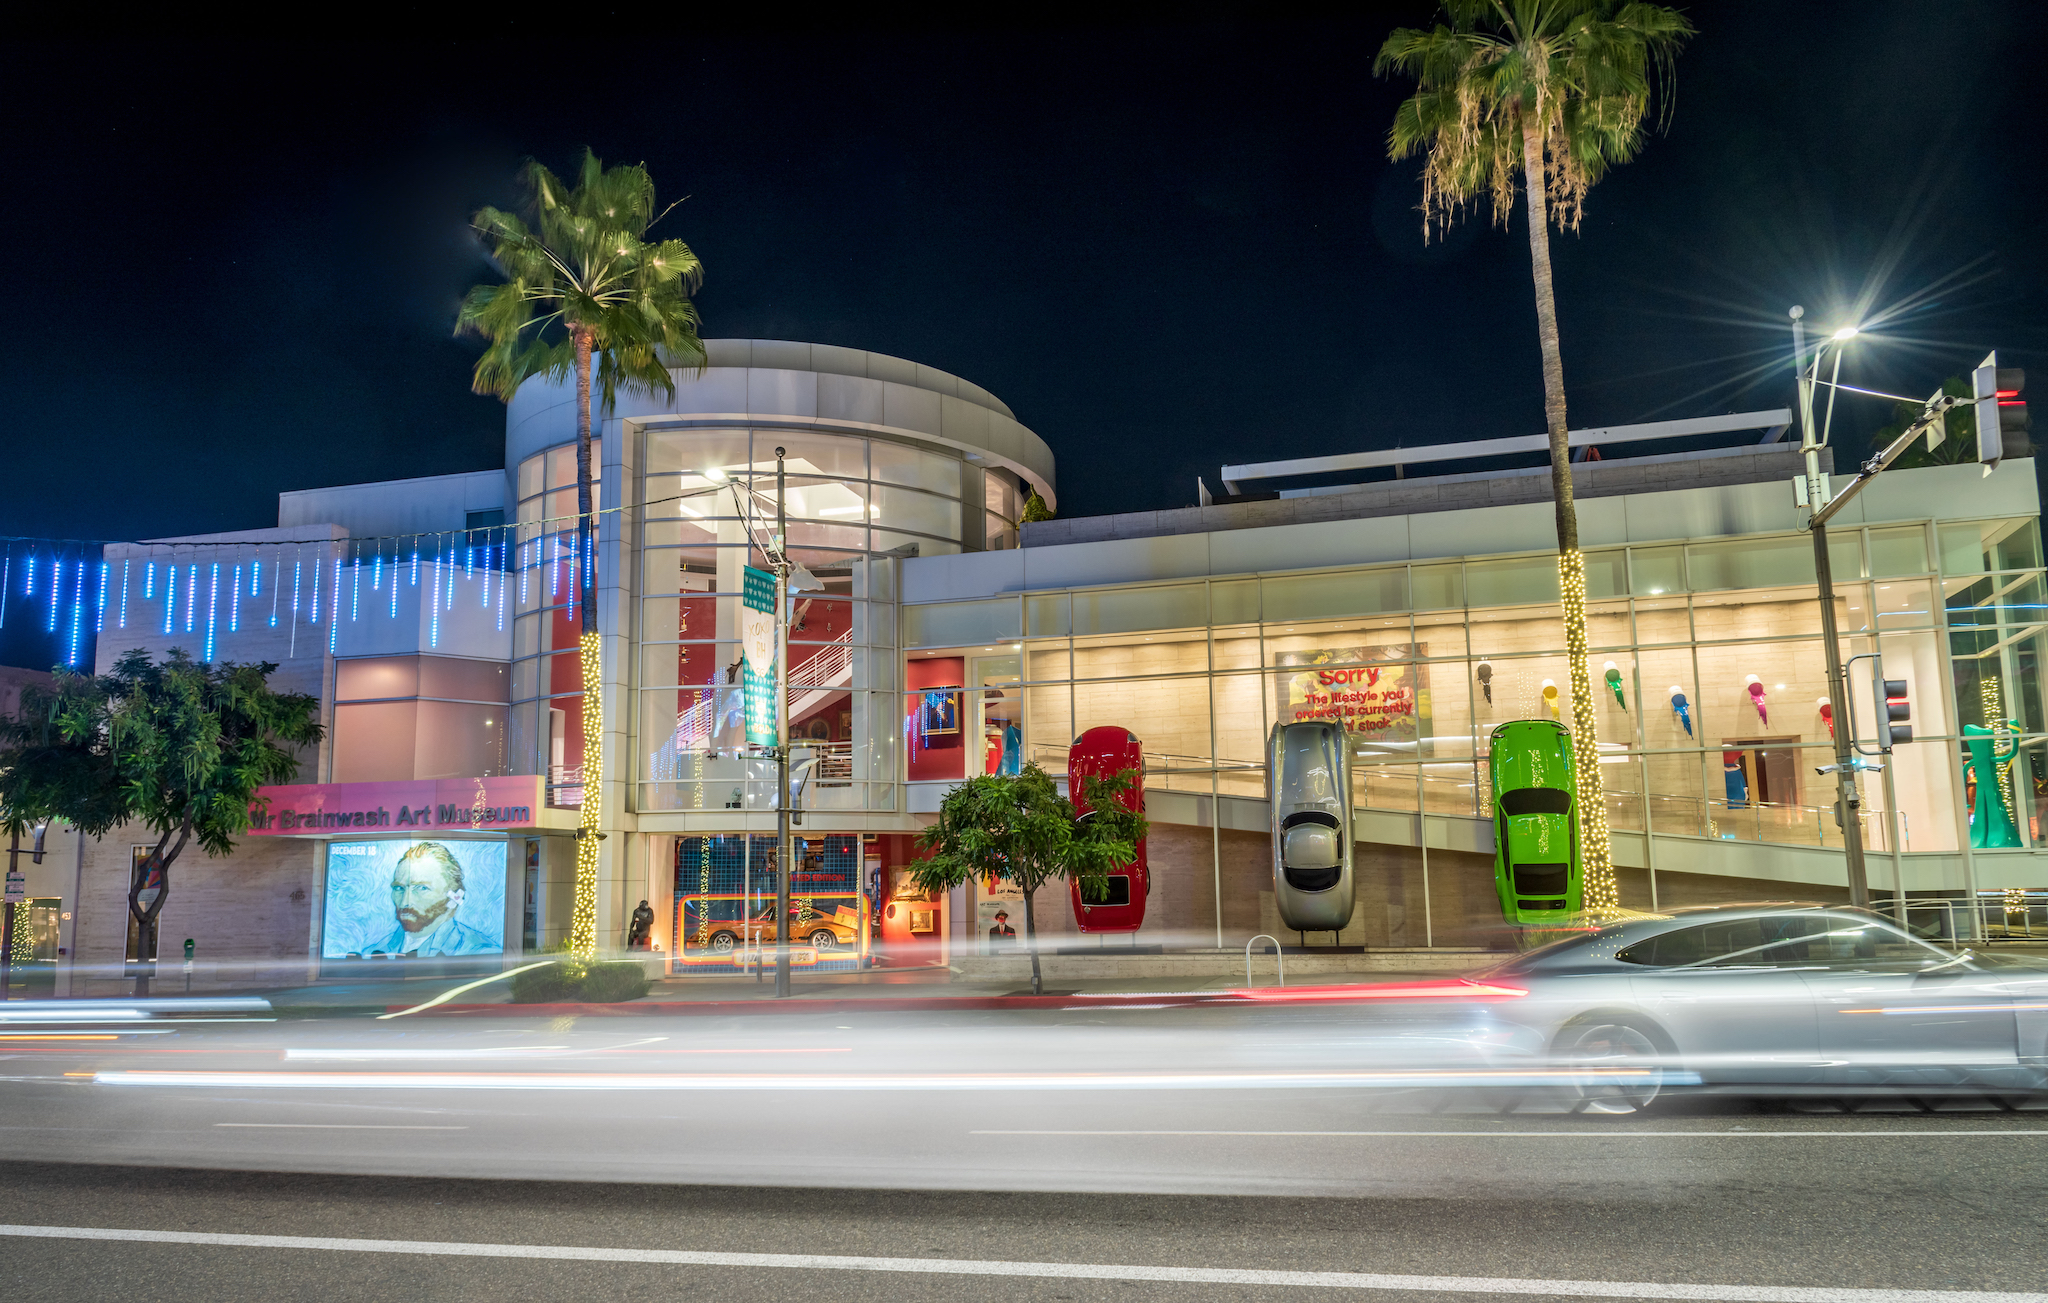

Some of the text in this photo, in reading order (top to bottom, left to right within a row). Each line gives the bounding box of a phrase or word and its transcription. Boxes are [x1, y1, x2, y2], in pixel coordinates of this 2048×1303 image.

[756, 641, 766, 659] BH
[1319, 667, 1380, 687] Sorry
[1305, 689, 1405, 705] The lifestyle you
[1296, 705, 1341, 719] ordered
[1345, 704, 1355, 717] is
[1358, 702, 1413, 716] currently
[1358, 717, 1392, 731] stock
[250, 804, 530, 829] Mr Brainwash Art Museum
[332, 845, 377, 856] DECEMBER 18
